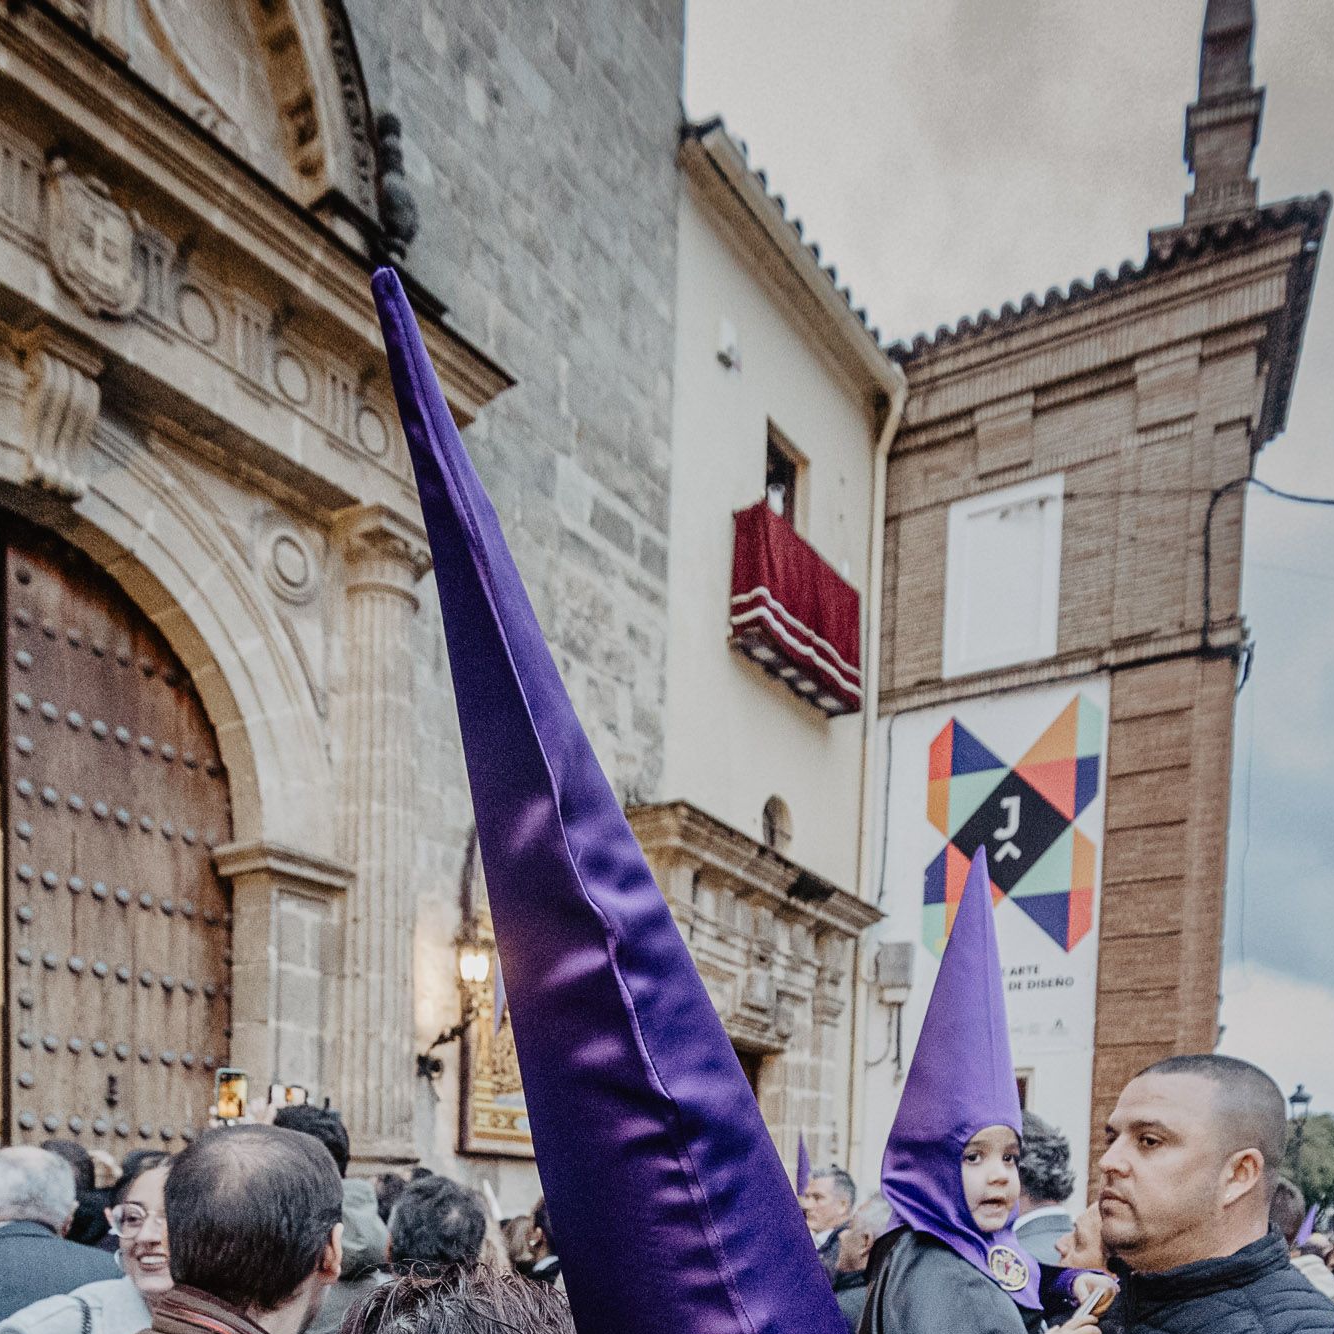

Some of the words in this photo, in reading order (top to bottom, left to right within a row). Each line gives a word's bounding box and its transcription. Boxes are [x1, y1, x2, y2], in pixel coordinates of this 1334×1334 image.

[1010, 965, 1039, 976] ARTE
[1008, 980, 1022, 991] DE
[1027, 974, 1075, 990] DISEÑO
